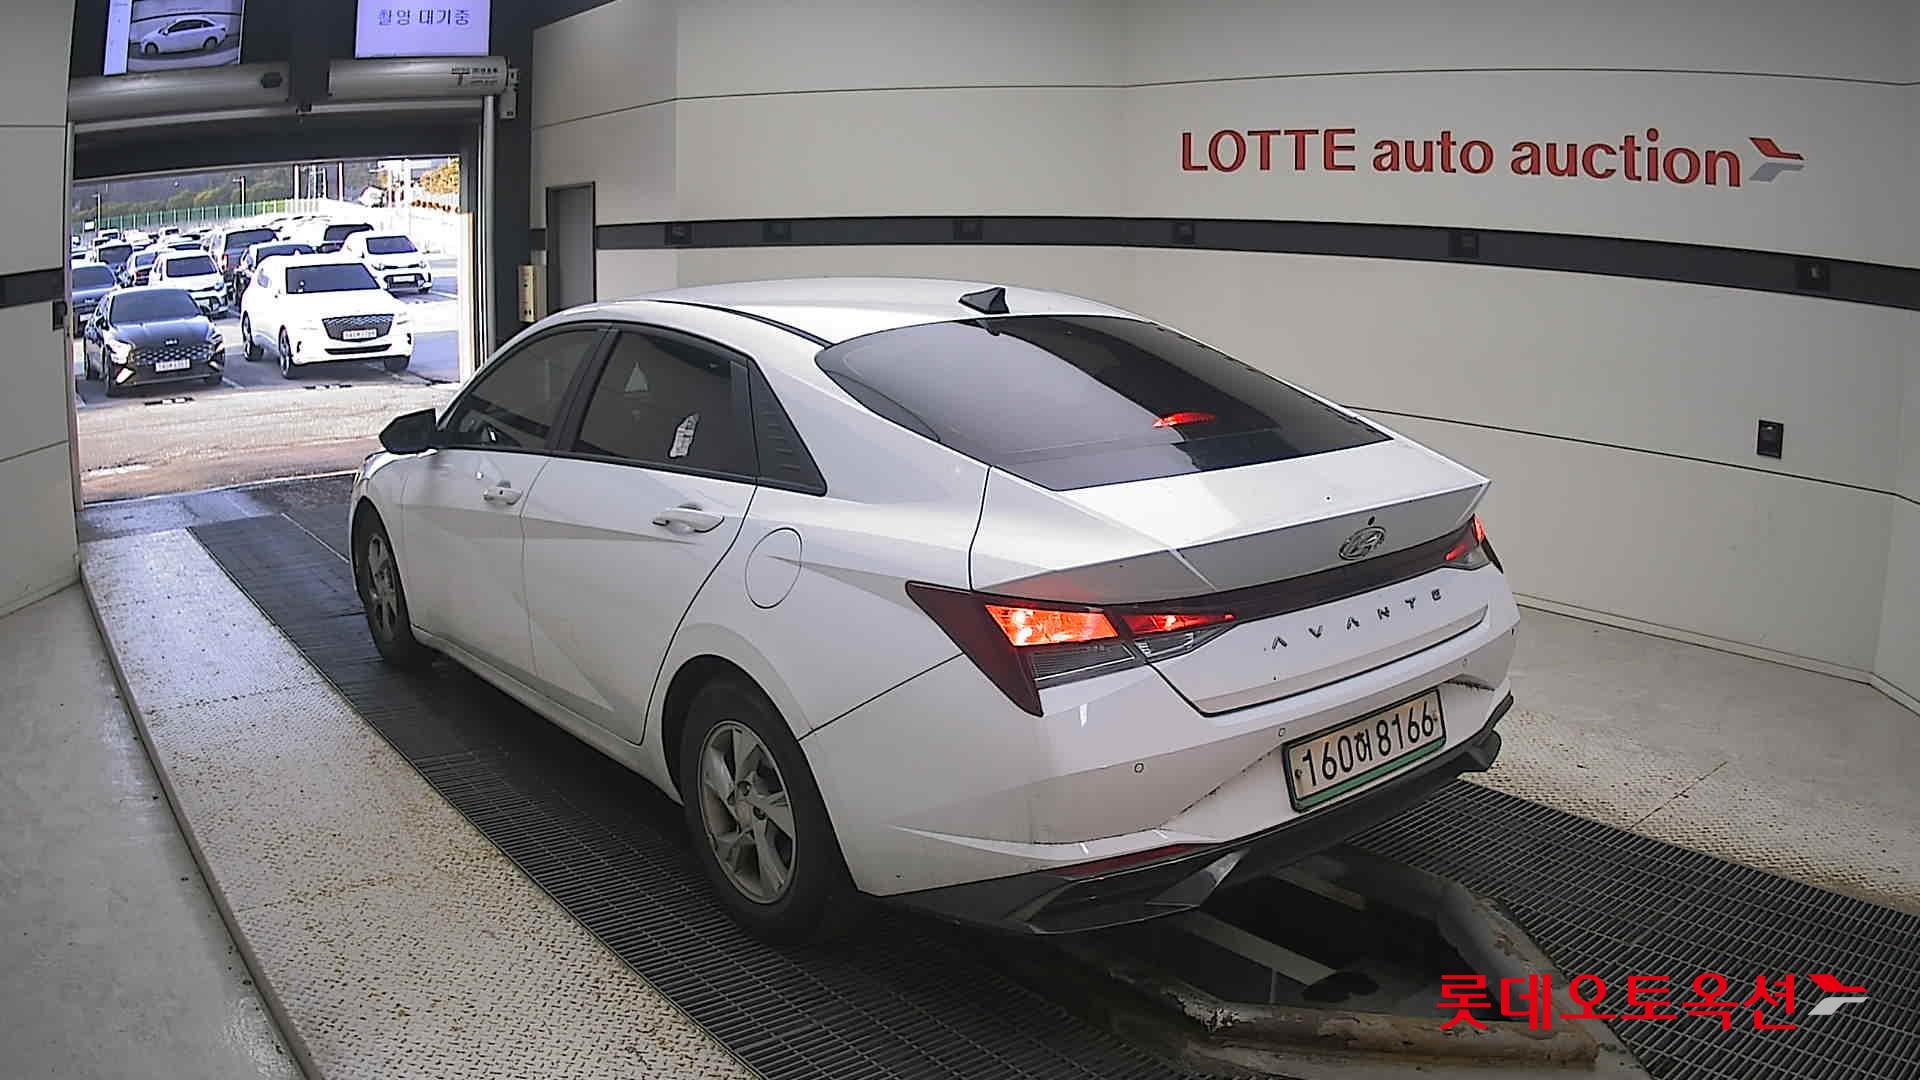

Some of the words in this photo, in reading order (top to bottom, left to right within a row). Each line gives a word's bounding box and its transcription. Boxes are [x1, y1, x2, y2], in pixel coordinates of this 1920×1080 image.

[419, 8, 470, 26] 대기중
[1181, 129, 1356, 171] LOTTE
[1373, 131, 1495, 175] auto
[1510, 129, 1742, 187] auction
[1271, 588, 1443, 650] AVANTE
